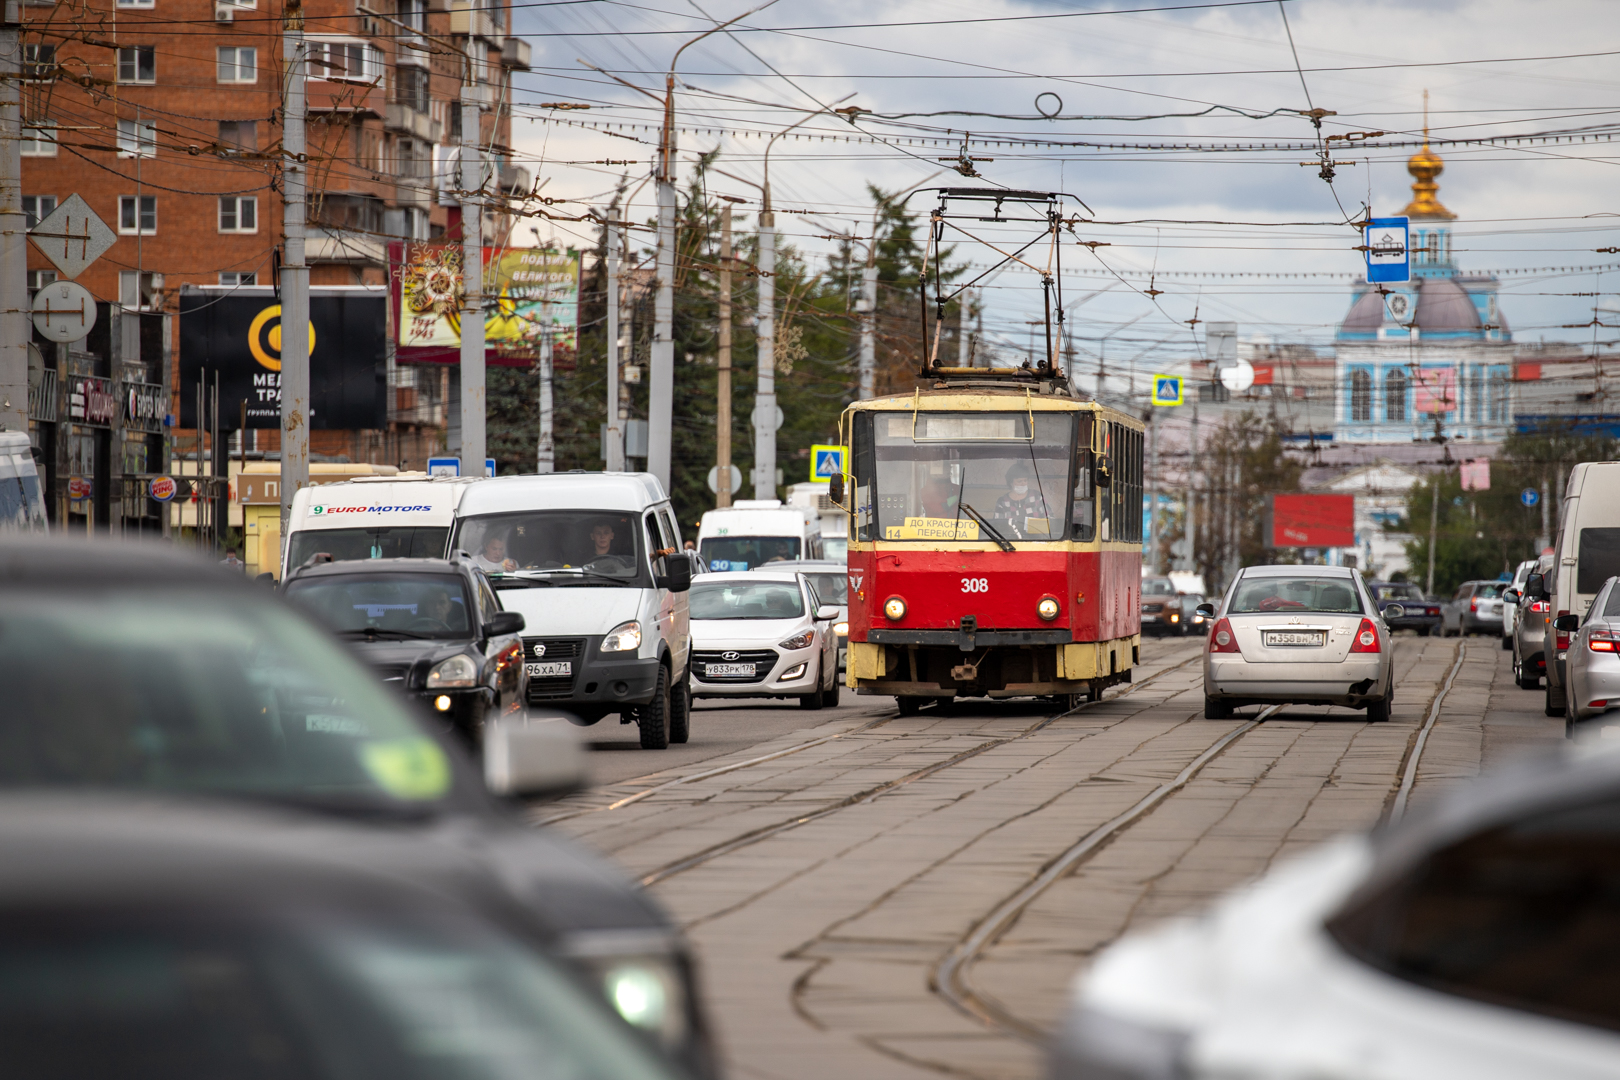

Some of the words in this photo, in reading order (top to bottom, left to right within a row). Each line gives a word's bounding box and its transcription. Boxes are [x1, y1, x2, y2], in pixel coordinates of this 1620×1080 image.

[520, 254, 574, 267] ПОДВИГУ
[409, 328, 435, 340] 1945
[152, 480, 172, 490] BURGER
[153, 484, 173, 496] KING
[314, 506, 323, 515] 9
[327, 505, 432, 514] EUROMOTORS
[910, 519, 924, 528] ДО
[926, 519, 976, 530] КРАСНОГО
[887, 529, 901, 539] 14
[917, 528, 968, 538] ПЕРЕКОПА
[711, 560, 729, 571] 30
[961, 577, 989, 593] 308
